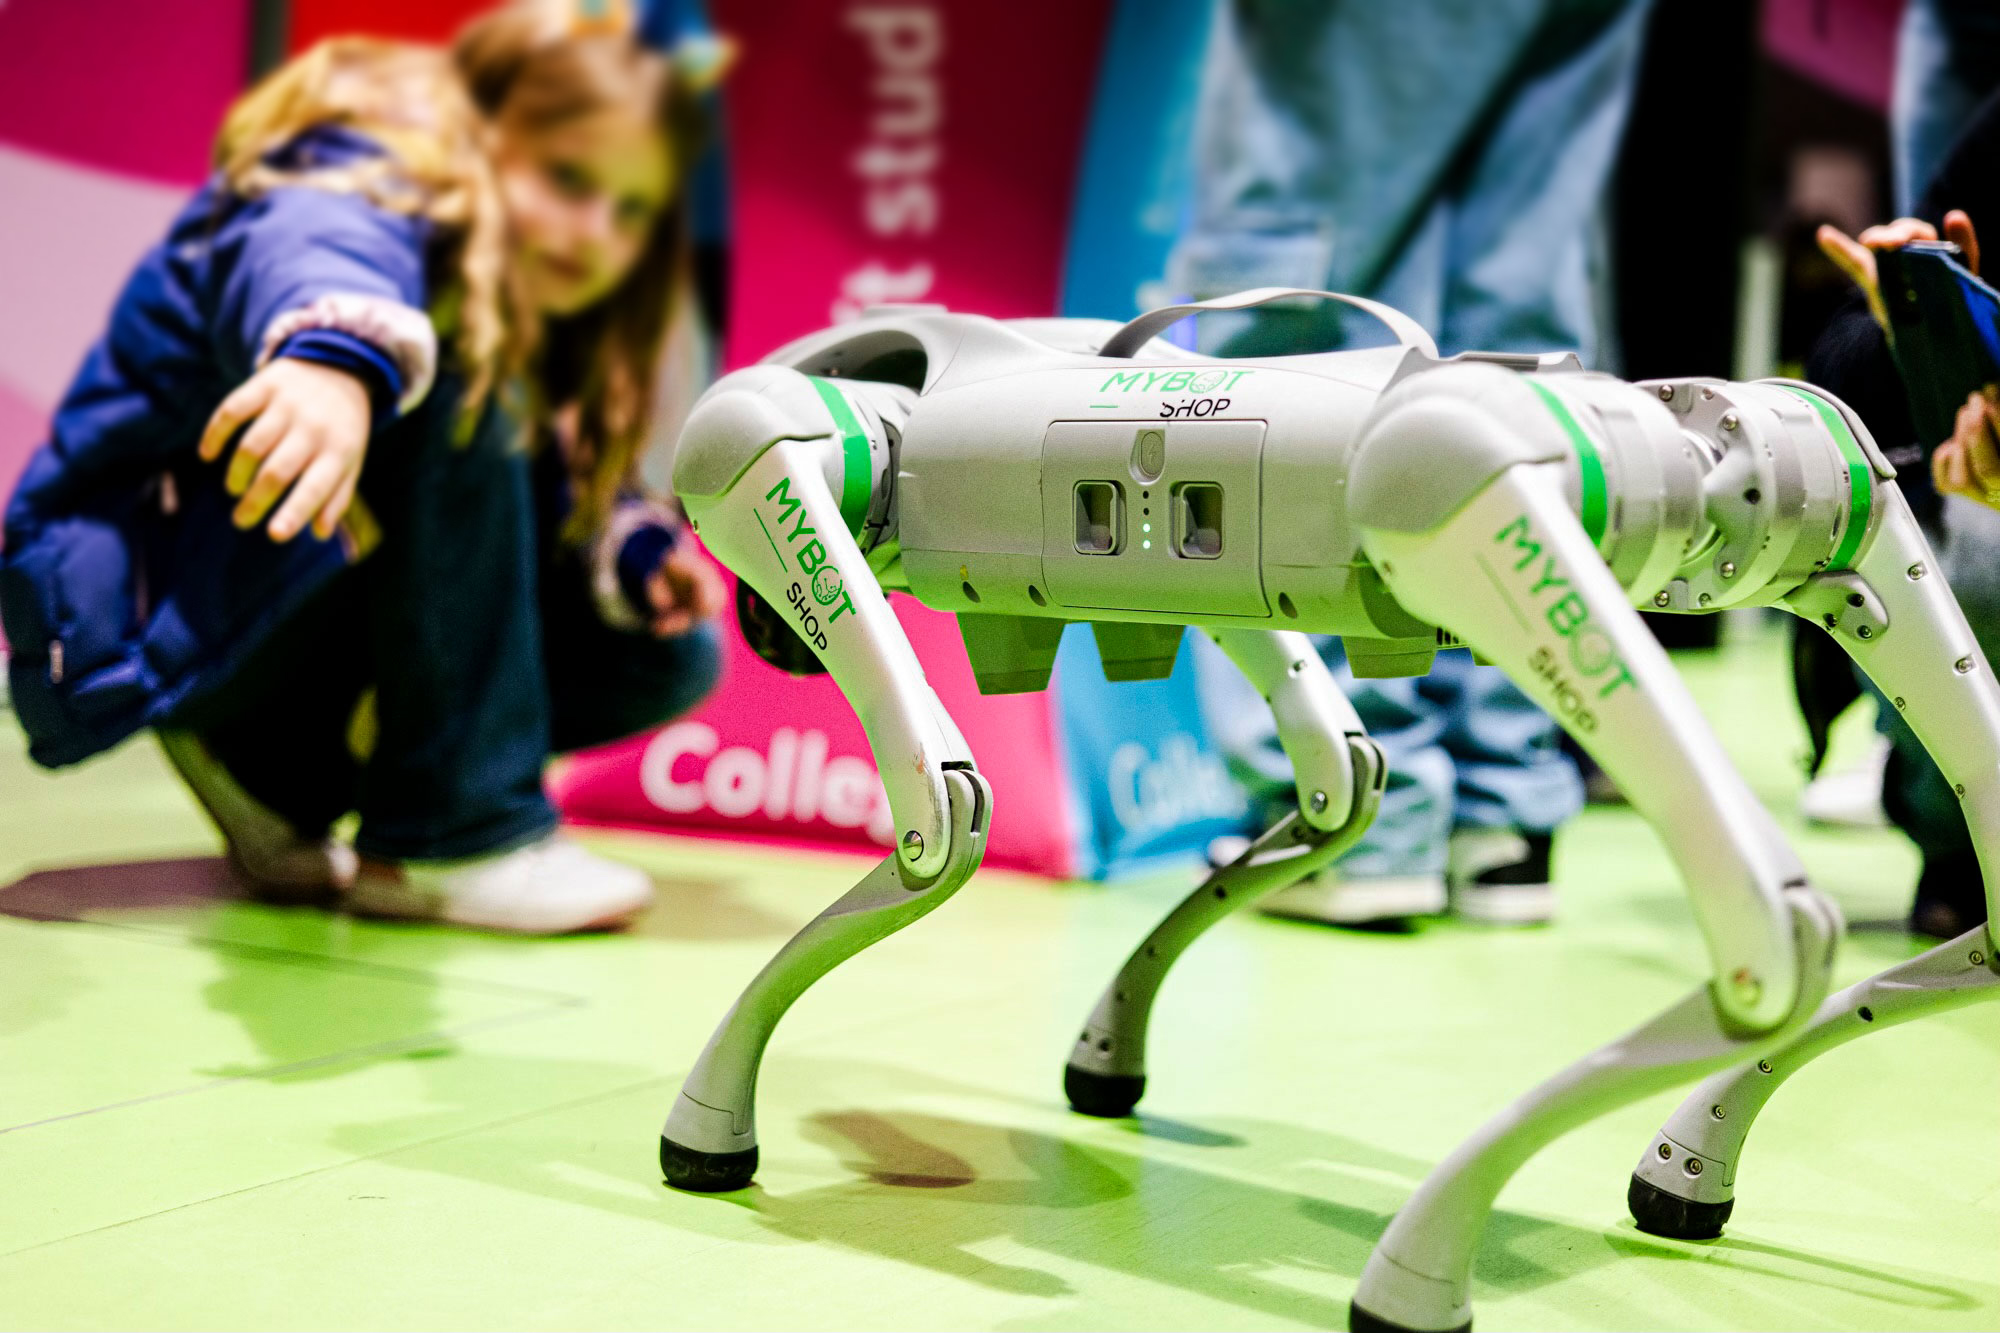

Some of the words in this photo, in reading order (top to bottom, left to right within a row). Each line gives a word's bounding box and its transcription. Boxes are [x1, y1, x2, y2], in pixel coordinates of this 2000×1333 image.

[1099, 370, 1256, 394] MYBOT
[1159, 398, 1231, 418] SHOP
[765, 476, 857, 624] MYBOT
[786, 581, 828, 651] SHOP
[1494, 514, 1638, 700] MYBOT
